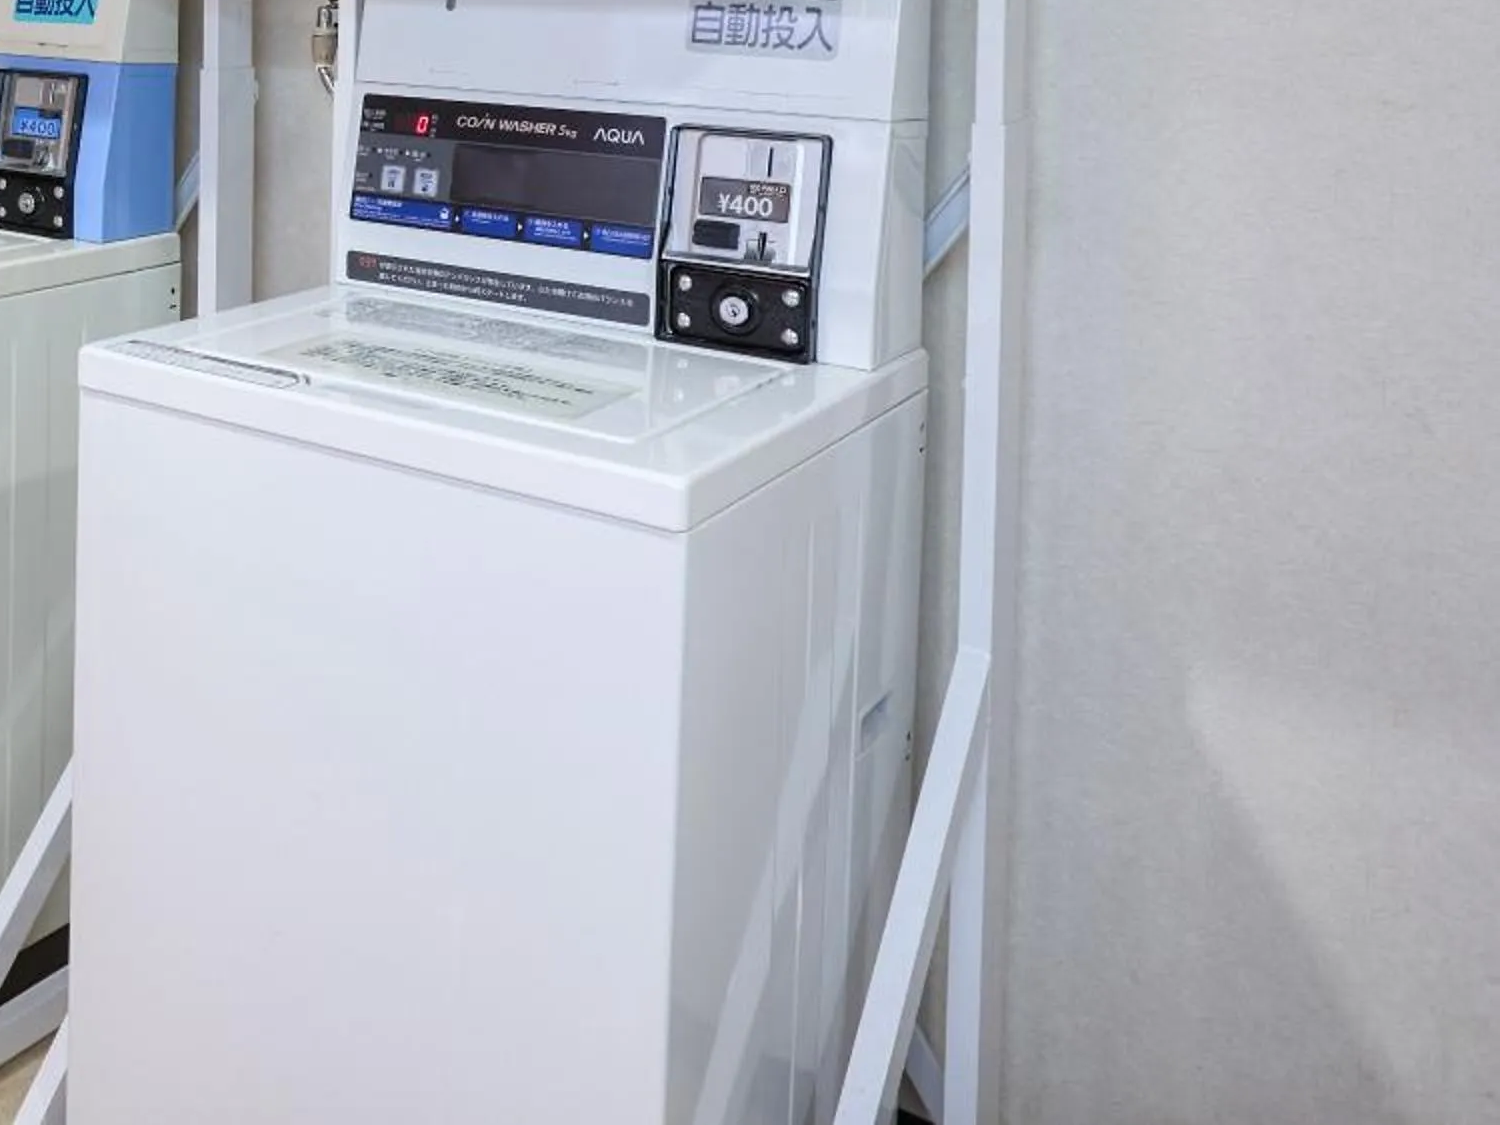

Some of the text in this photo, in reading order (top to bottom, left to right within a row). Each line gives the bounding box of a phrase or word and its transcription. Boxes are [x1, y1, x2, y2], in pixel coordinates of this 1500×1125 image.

[691, 1, 833, 52] 自動投入
[416, 115, 430, 134] 0
[499, 118, 557, 137] WASHER
[557, 123, 578, 139] 5kg
[593, 127, 646, 146] AQUA
[717, 192, 773, 217] ¥400
